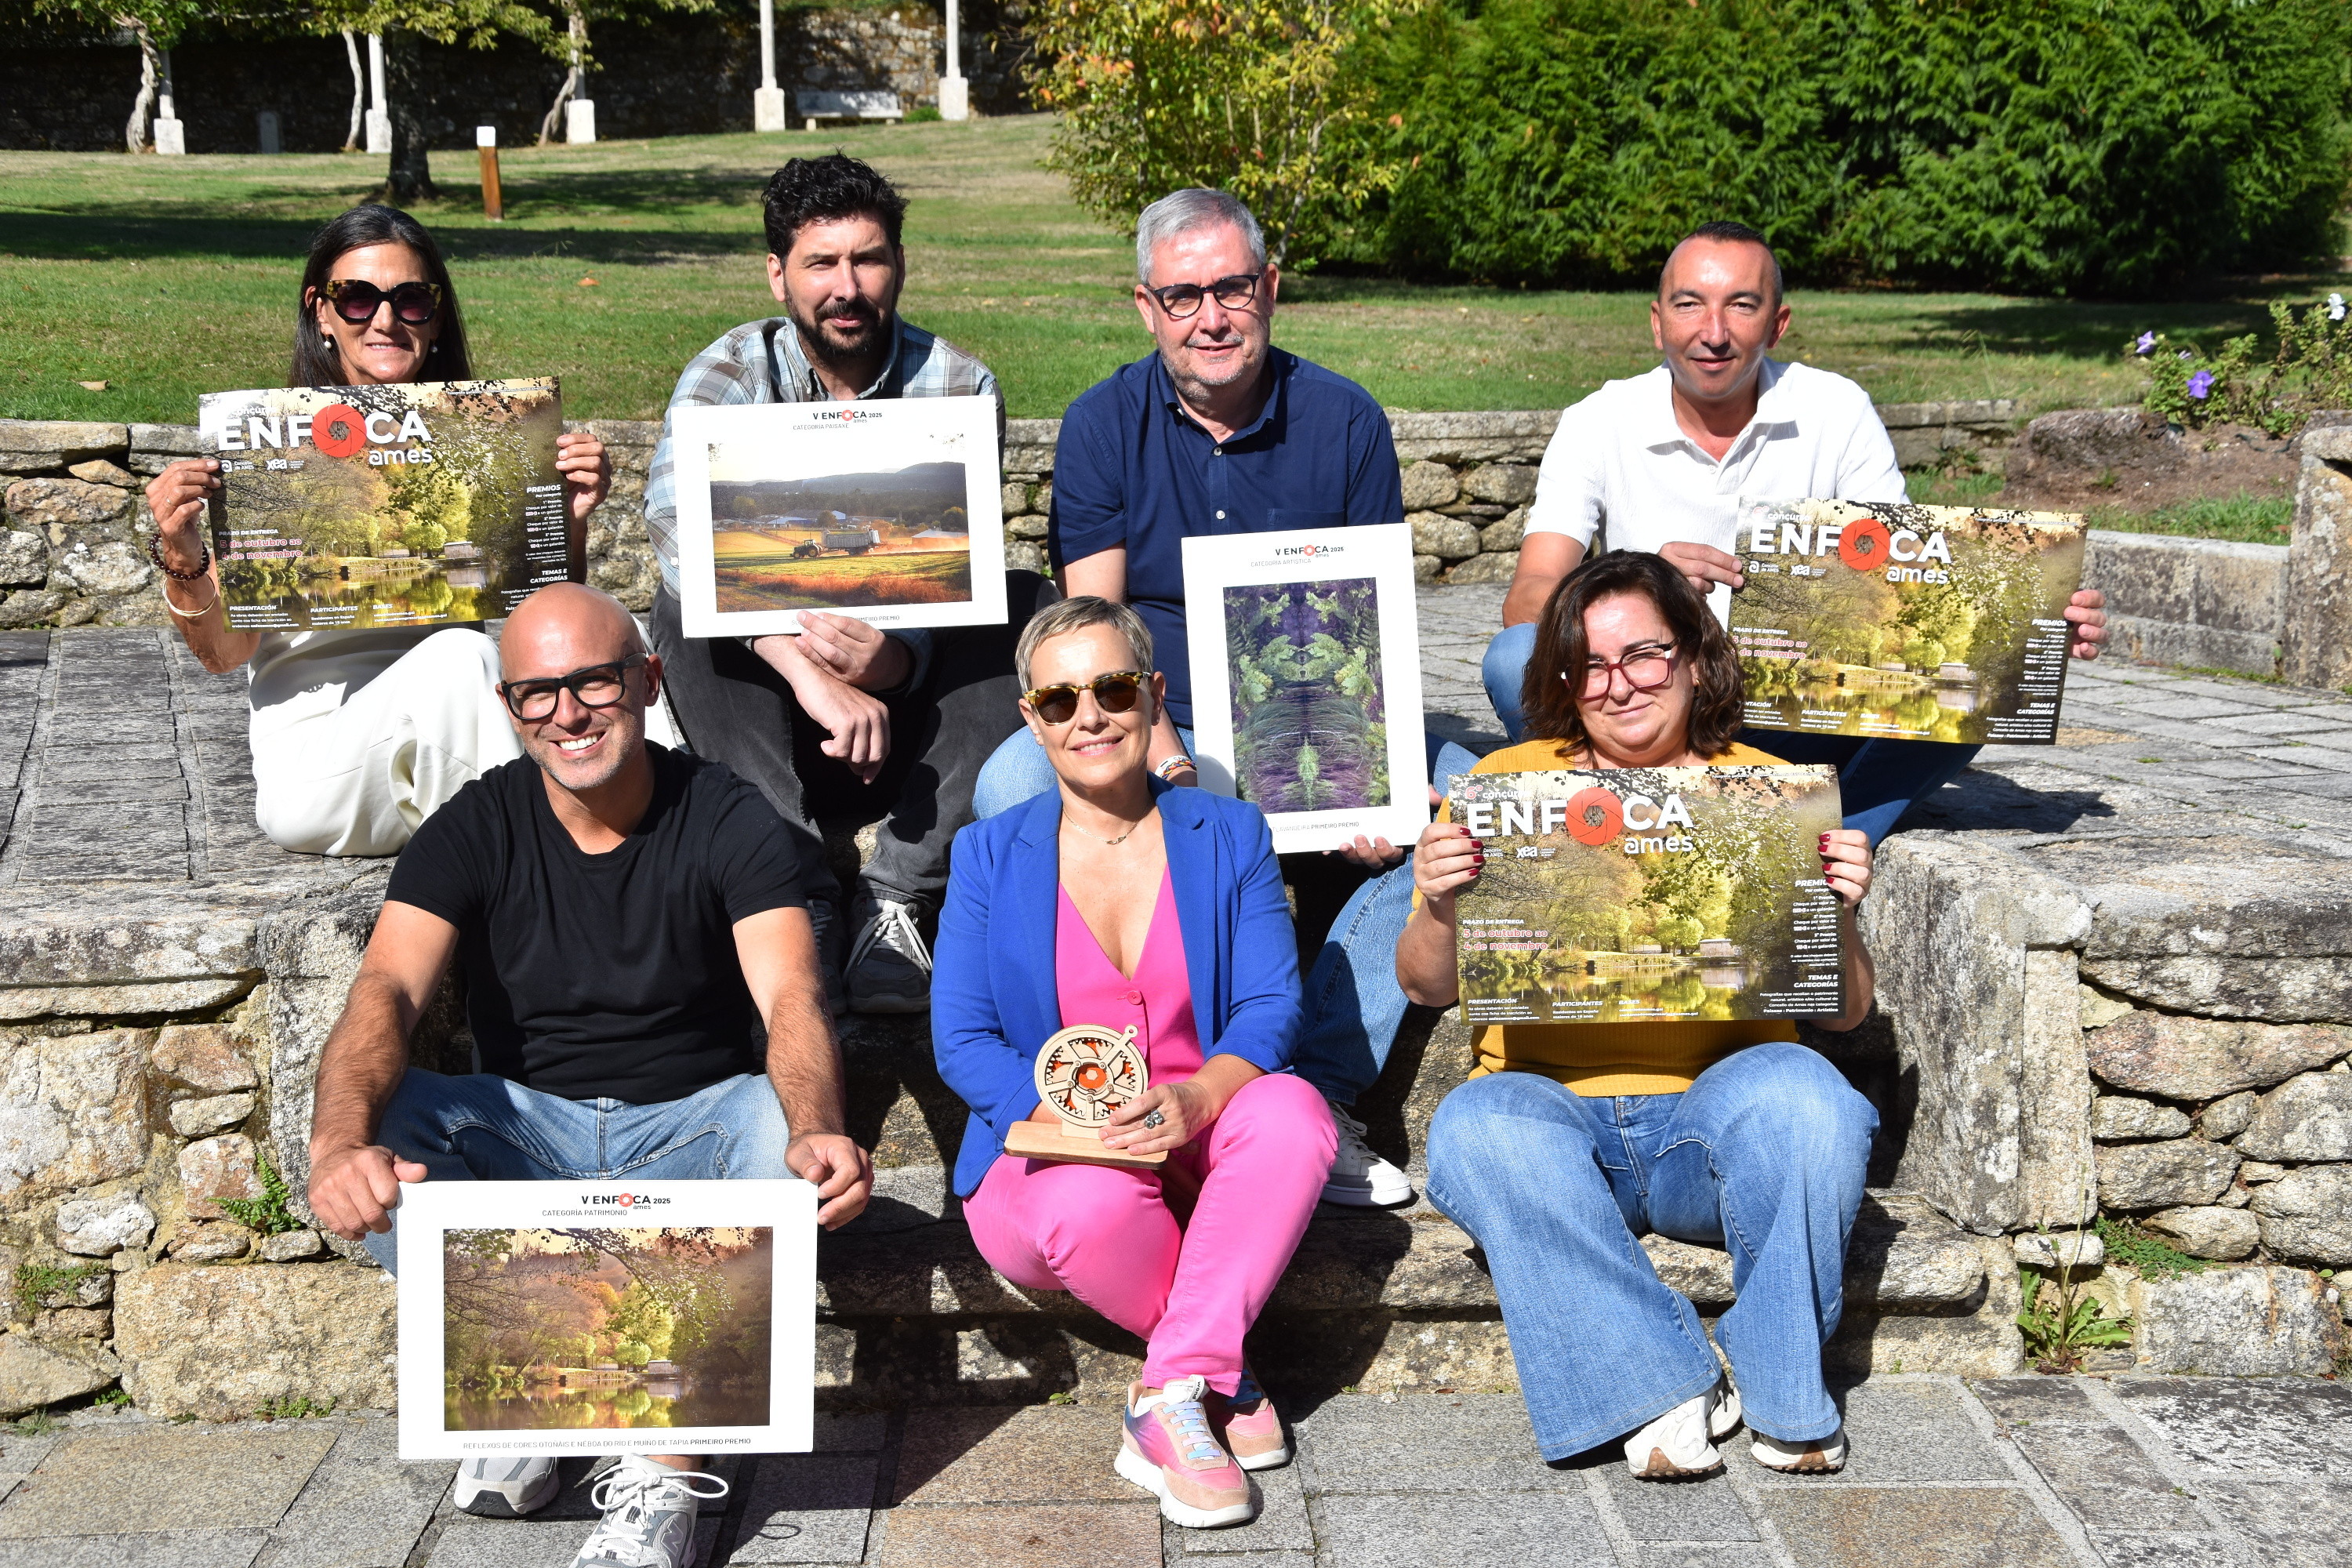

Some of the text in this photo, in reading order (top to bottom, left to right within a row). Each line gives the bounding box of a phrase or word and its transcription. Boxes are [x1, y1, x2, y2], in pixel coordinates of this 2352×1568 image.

[822, 409, 867, 422] ENFOCA
[218, 404, 433, 458] ENFOCA
[368, 448, 433, 466] ames
[266, 459, 288, 470] xea
[526, 485, 561, 493] PREMIOS
[220, 538, 303, 548] 5 de outubro ao
[1750, 518, 1952, 571] ENFOCA
[221, 549, 303, 561] 4 de novembro
[1284, 544, 1329, 556] ENFOCA
[1790, 564, 1810, 575] xea
[1886, 566, 1950, 584] ames
[529, 575, 568, 584] CATEGORÍAS
[2031, 619, 2067, 627] PREMIOS
[1740, 637, 1753, 645] de
[1755, 637, 1795, 648] outubro
[1740, 648, 1752, 657] de
[1754, 649, 1806, 659] novembro
[1464, 784, 1483, 800] 6º
[1467, 786, 1695, 845] ENFOCA
[1624, 834, 1693, 855] ames
[1515, 845, 1538, 858] xea
[1464, 928, 1471, 938] 5
[1473, 930, 1486, 938] de
[1488, 928, 1534, 938] outubro
[1474, 942, 1488, 951] de
[1490, 941, 1548, 951] novembro
[582, 1196, 589, 1205] V
[593, 1192, 652, 1207] ENFOCA
[542, 1208, 583, 1217] CATEGORÍA
[615, 1439, 626, 1447] RÍO
